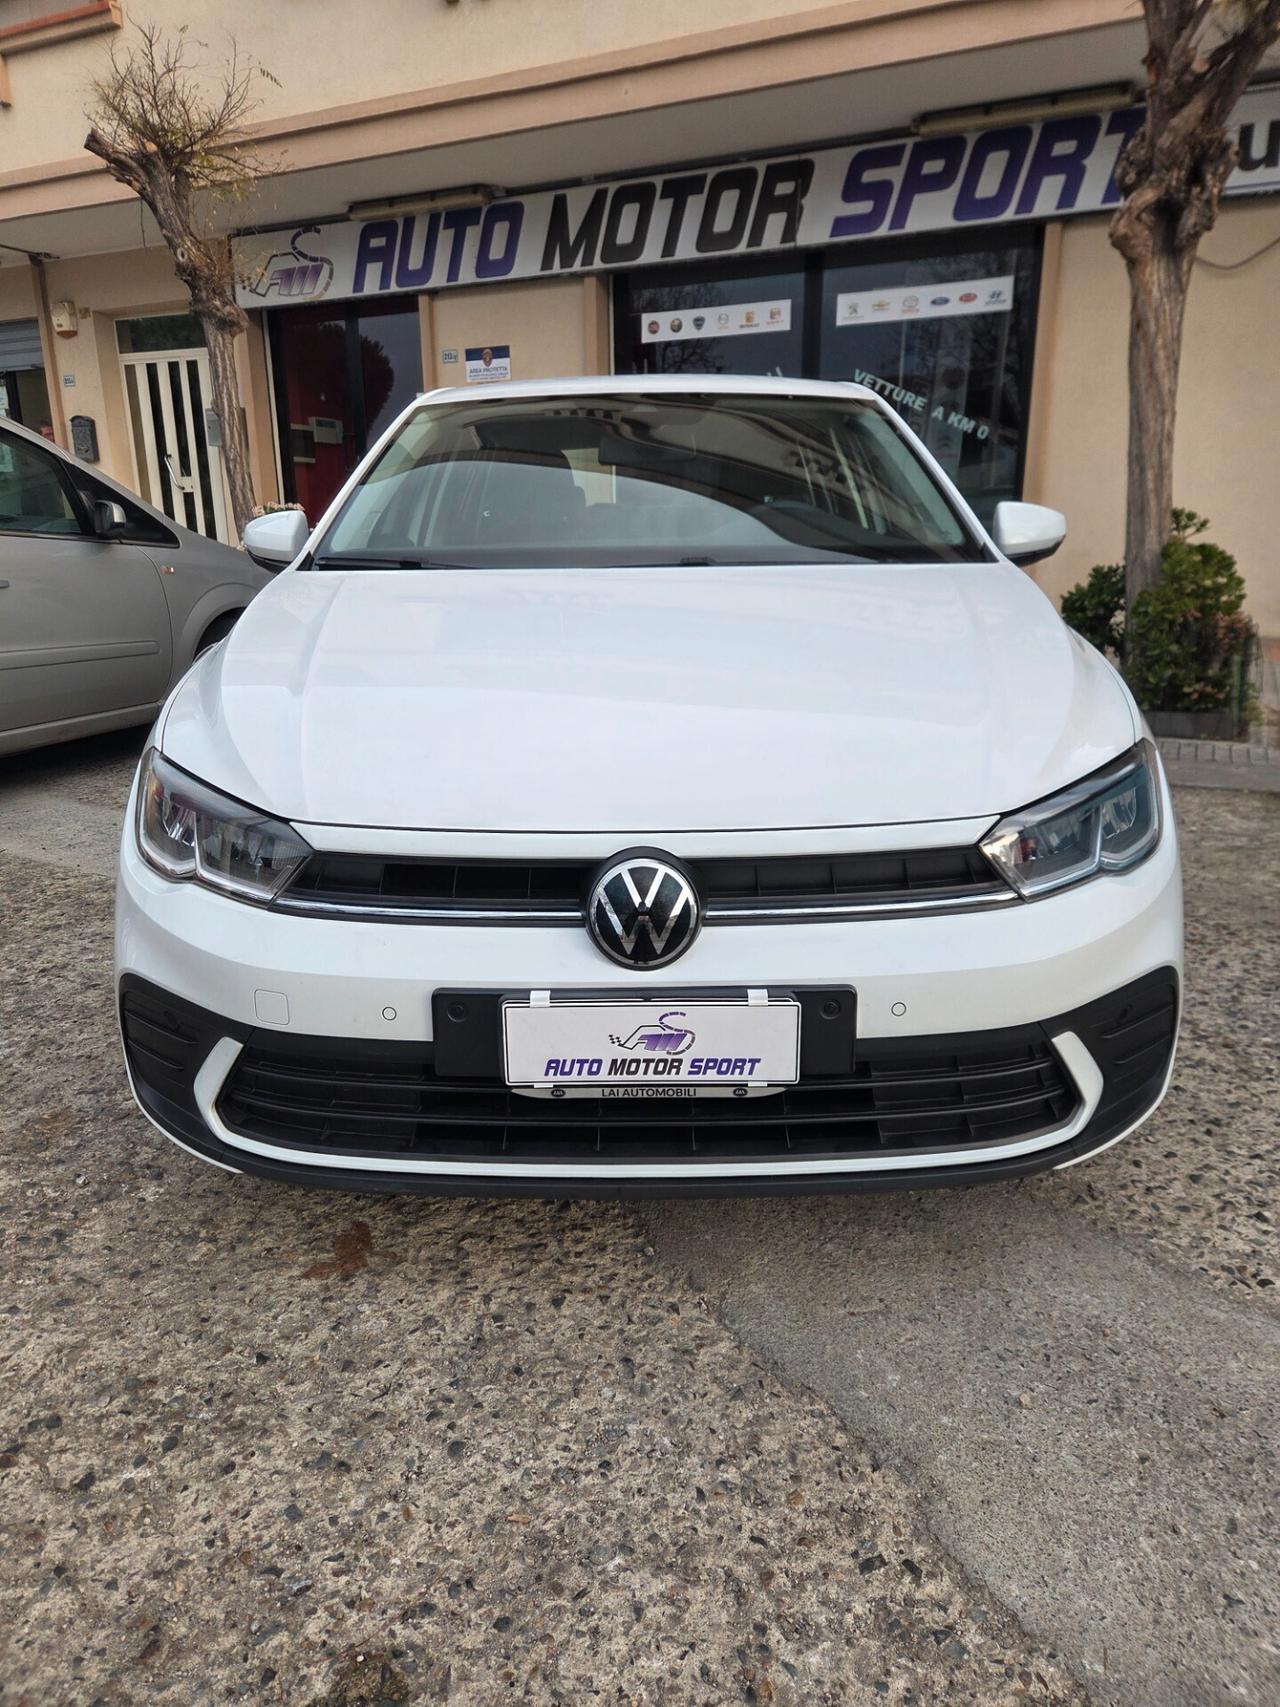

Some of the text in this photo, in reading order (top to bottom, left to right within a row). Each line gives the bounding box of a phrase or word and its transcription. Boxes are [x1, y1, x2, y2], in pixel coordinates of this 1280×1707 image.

[352, 200, 525, 294] AUTO
[540, 158, 816, 271] MOTOR
[854, 369, 927, 411] VETTURE
[931, 405, 944, 420] A
[947, 412, 976, 433] KM
[544, 1058, 761, 1076] AUTO MOTOR SPORT
[601, 1088, 697, 1097] LAI AUTOMOBILI
